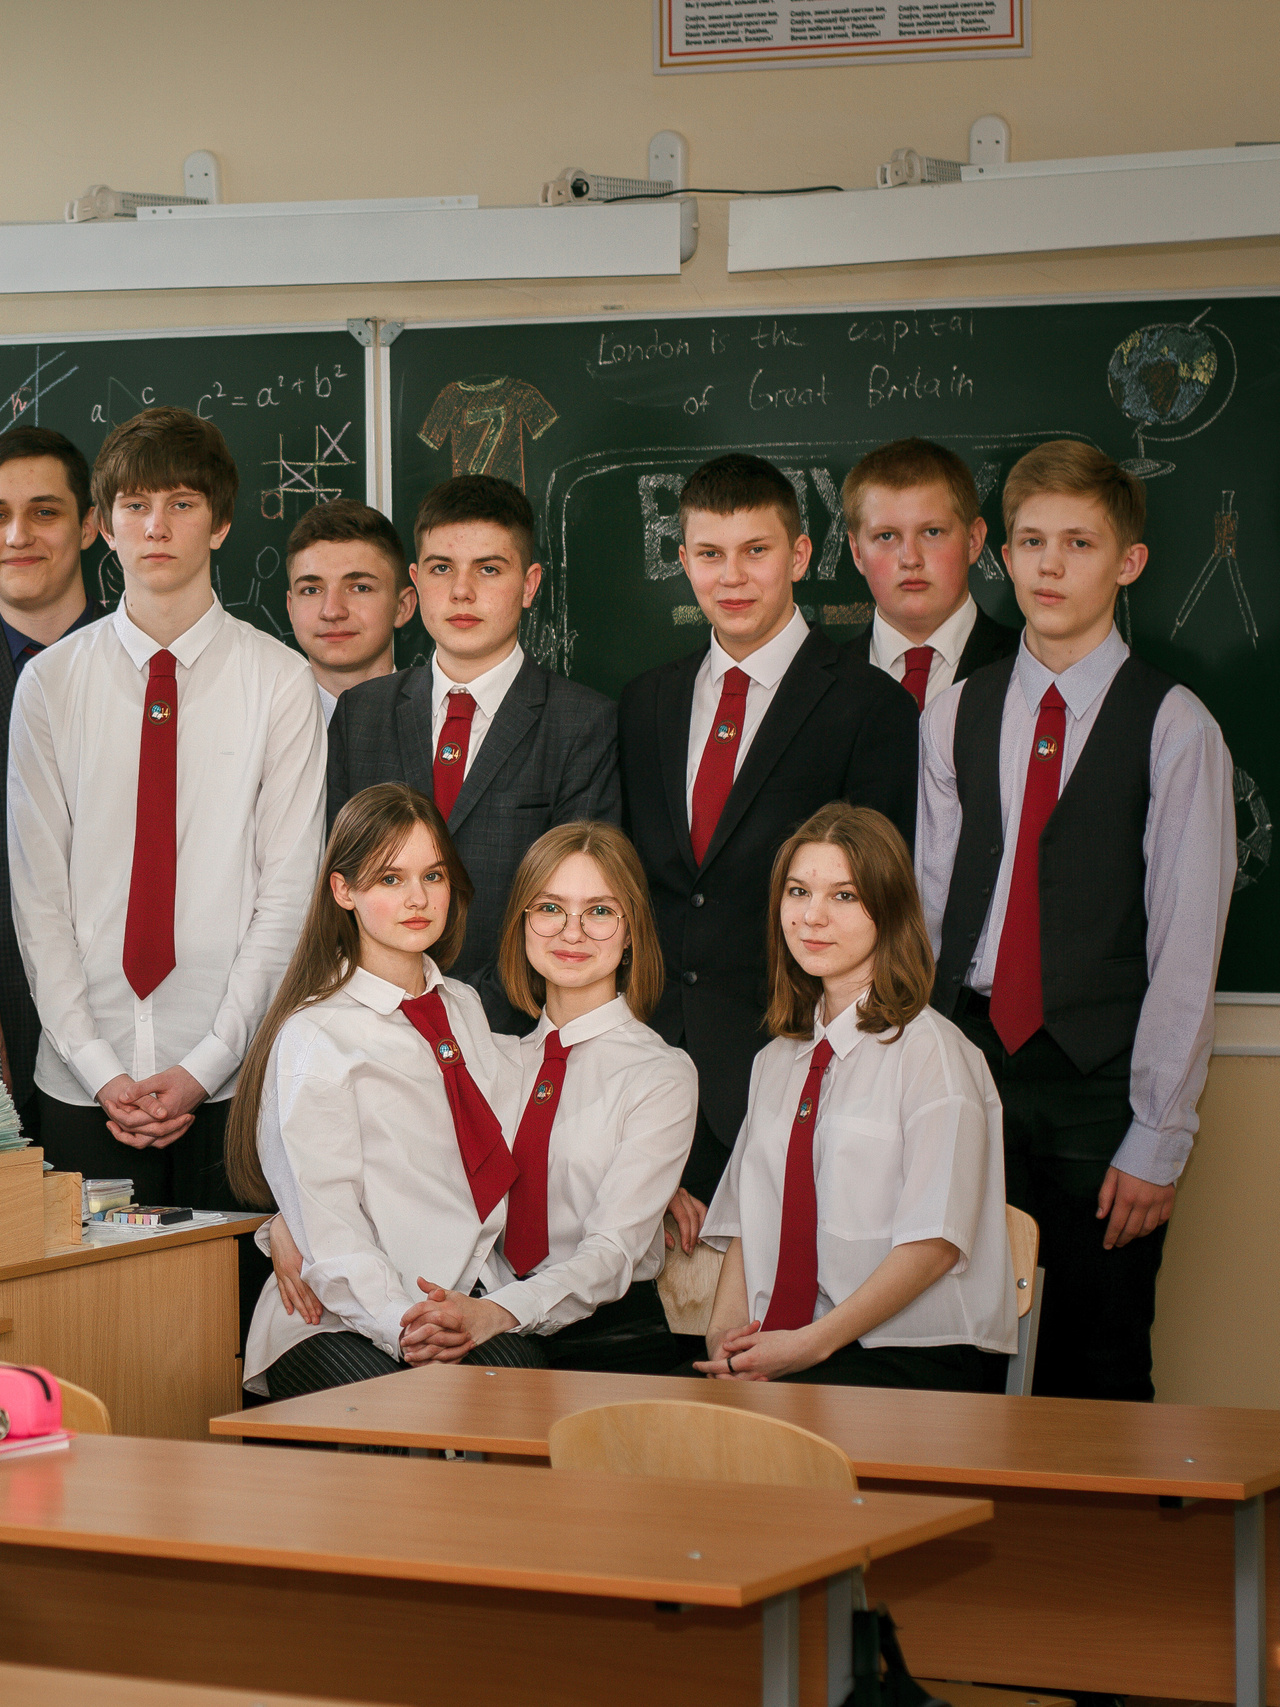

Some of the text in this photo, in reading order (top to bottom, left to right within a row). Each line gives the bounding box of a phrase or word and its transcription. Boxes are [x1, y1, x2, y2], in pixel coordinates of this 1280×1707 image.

[599, 311, 973, 365] London is the capital
[683, 364, 973, 414] of Great Britain
[466, 405, 504, 474] 7
